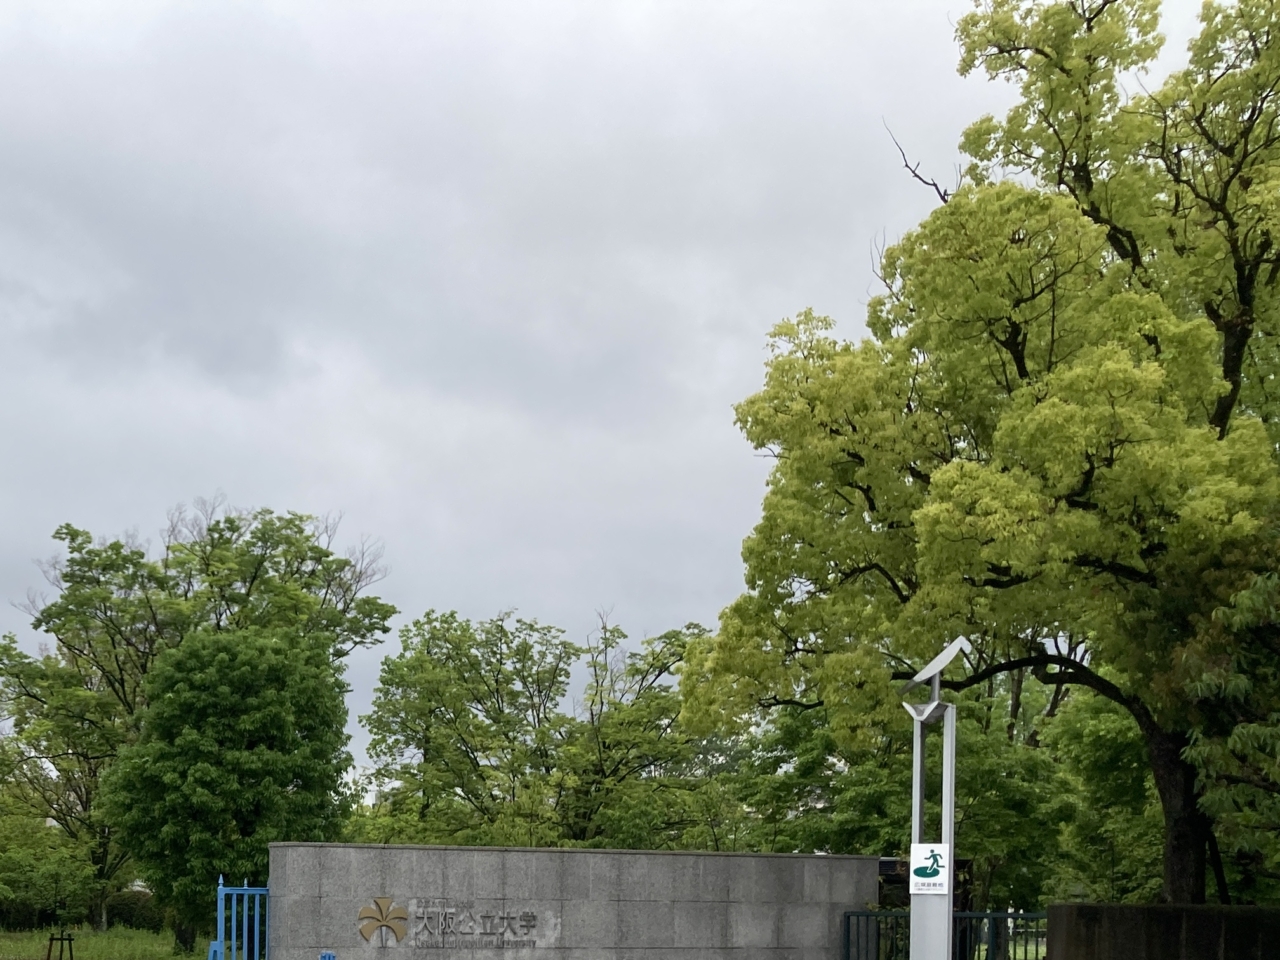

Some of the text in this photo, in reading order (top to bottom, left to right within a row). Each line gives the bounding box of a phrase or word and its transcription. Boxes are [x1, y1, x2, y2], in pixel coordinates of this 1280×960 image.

[415, 910, 537, 936] 大阪公立大学
